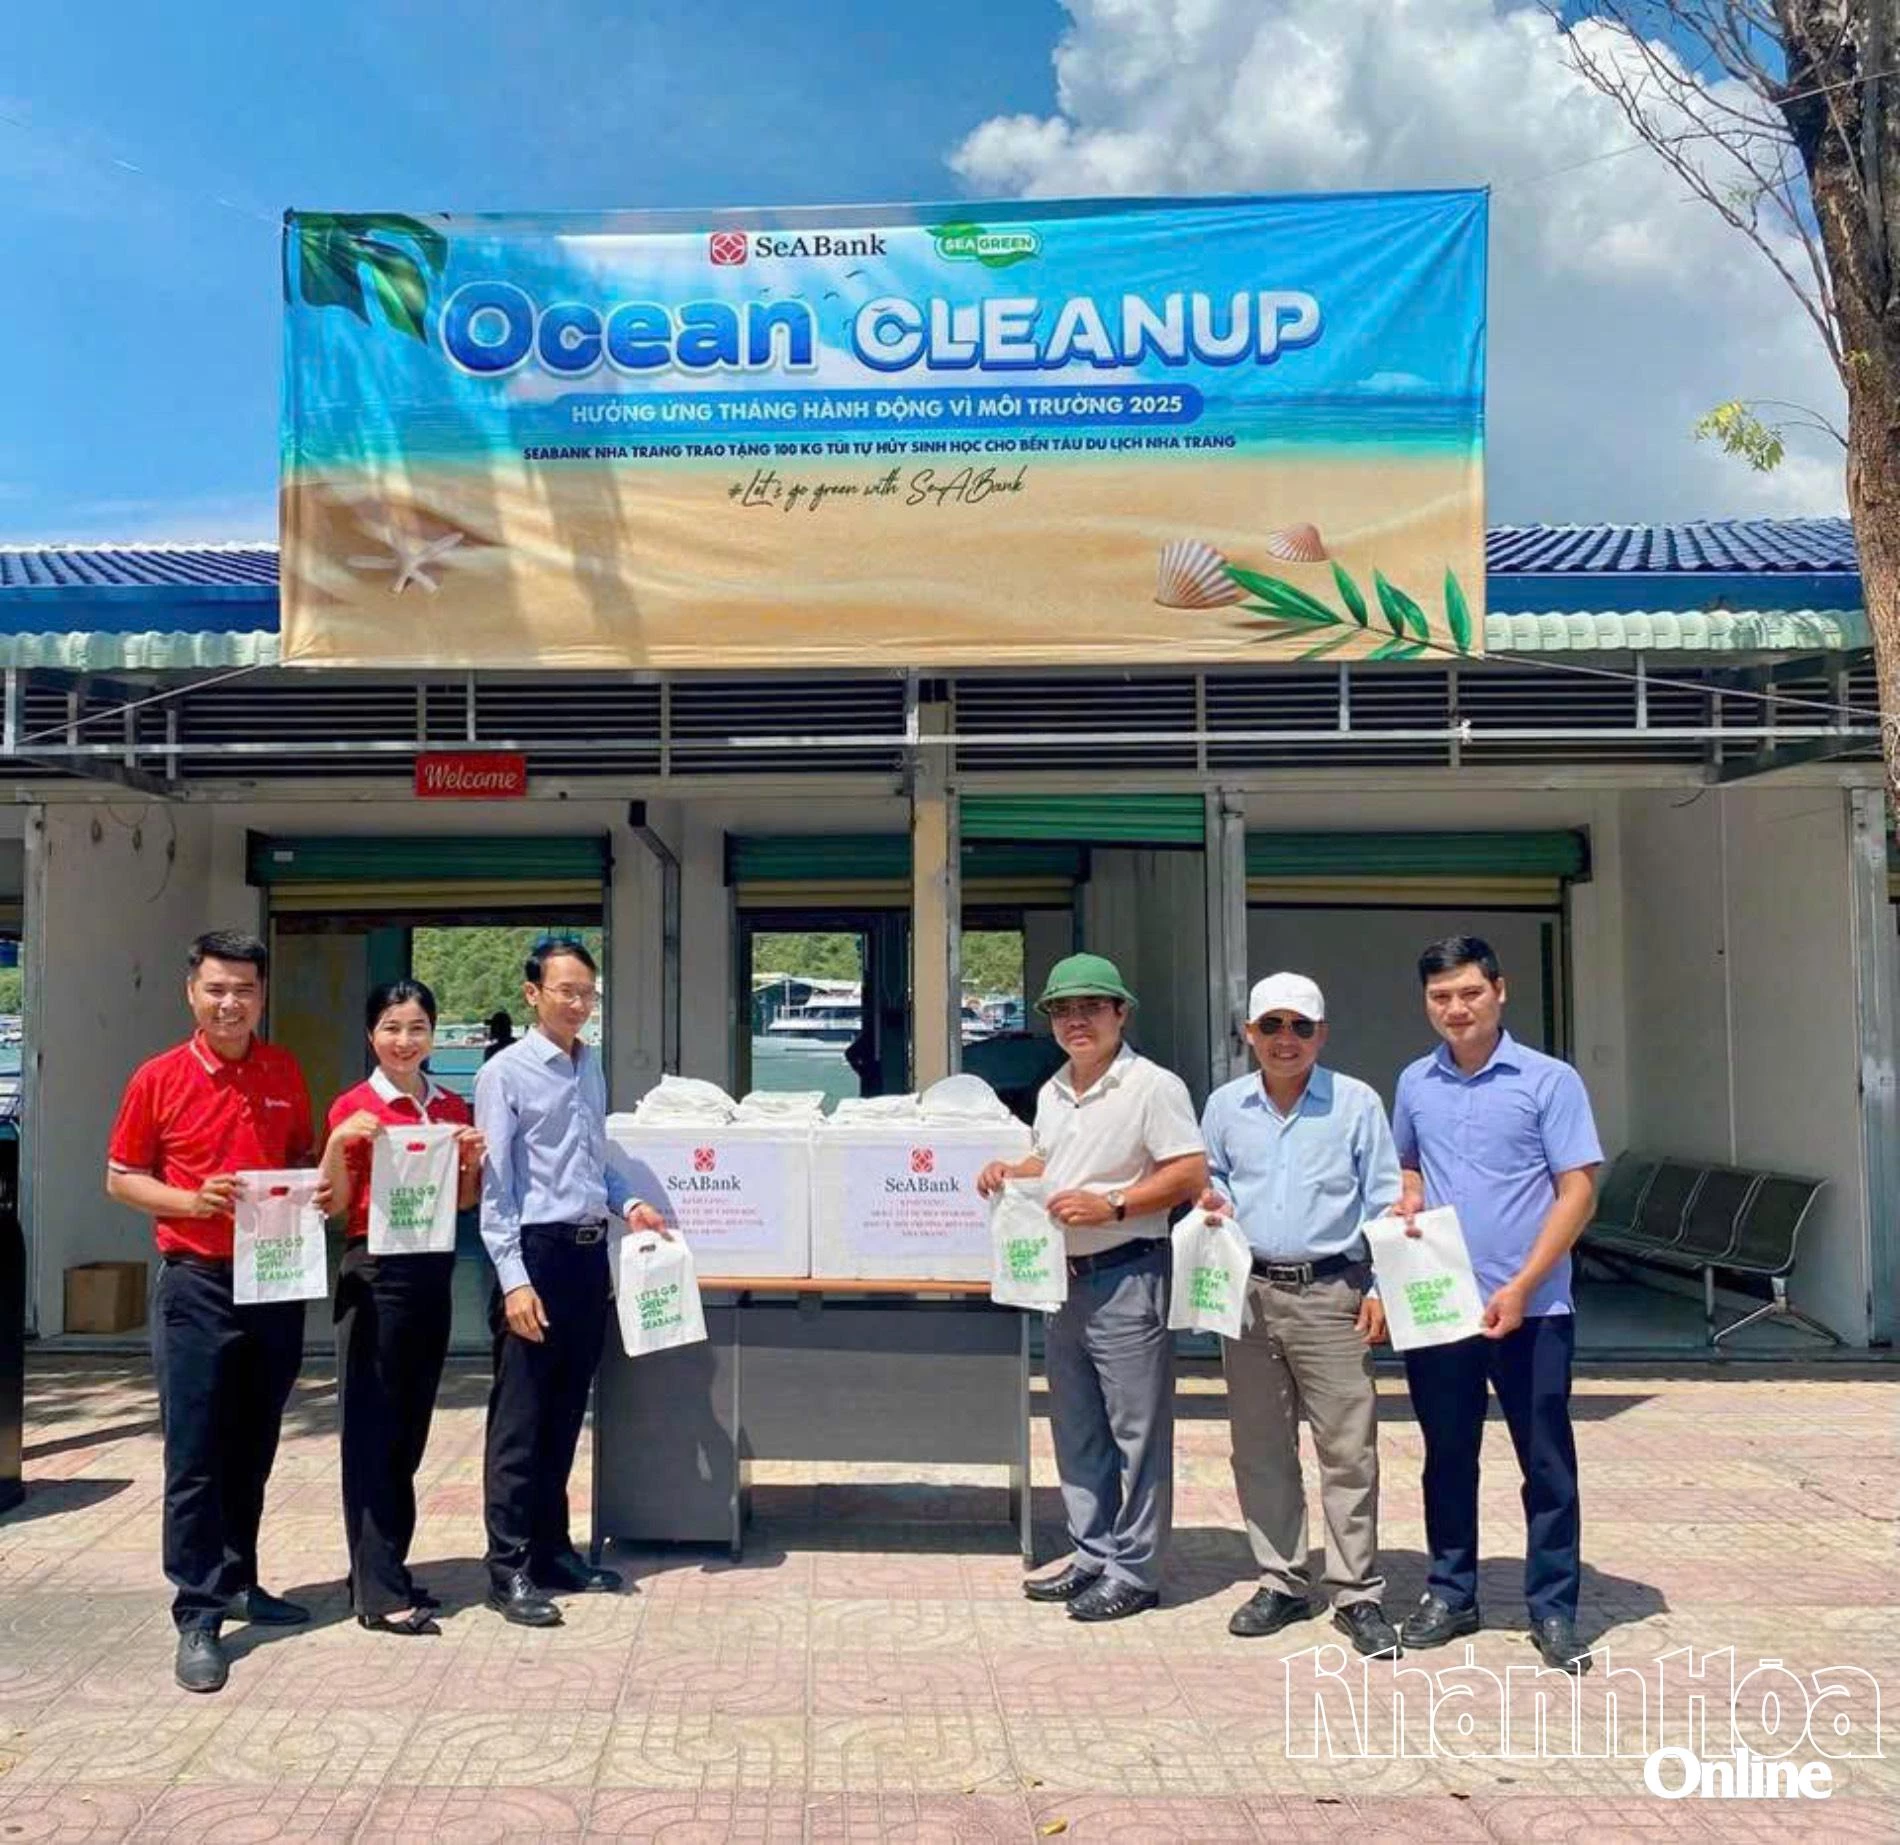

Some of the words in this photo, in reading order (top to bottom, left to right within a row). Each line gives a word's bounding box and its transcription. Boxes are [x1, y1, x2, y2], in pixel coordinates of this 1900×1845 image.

[755, 233, 887, 258] SeABank
[440, 280, 817, 378] Ocean
[853, 290, 1325, 371] CLEANUP
[718, 398, 797, 420] THÁNG
[803, 396, 869, 418] HÀNH
[876, 395, 943, 422] ĐỘNG
[950, 394, 972, 417] VÌ
[978, 393, 1022, 417] MÔI
[1029, 393, 1124, 416] TRƯỜNG
[1129, 395, 1182, 414] 2025
[523, 446, 592, 460] SEABANK
[594, 445, 628, 459] NHA
[632, 444, 682, 458] TRANG
[685, 443, 726, 457] TRAO
[774, 442, 798, 455] 100
[801, 442, 823, 455] KG
[827, 439, 849, 454] TÚI
[853, 441, 870, 457] TỰ
[912, 441, 946, 453] SINH
[950, 440, 981, 455] HỌC
[985, 439, 1016, 452] CHO
[1086, 438, 1107, 450] DU
[1110, 437, 1143, 452] LỊCH
[1146, 436, 1179, 449] NHA
[1184, 435, 1236, 448] TRANG
[784, 483, 808, 512] go
[809, 481, 857, 511] green
[864, 466, 901, 497] with
[906, 464, 1028, 506] SeABank
[425, 762, 518, 789] Welcome
[667, 1175, 741, 1191] SeABank
[885, 1177, 960, 1192] SeABank
